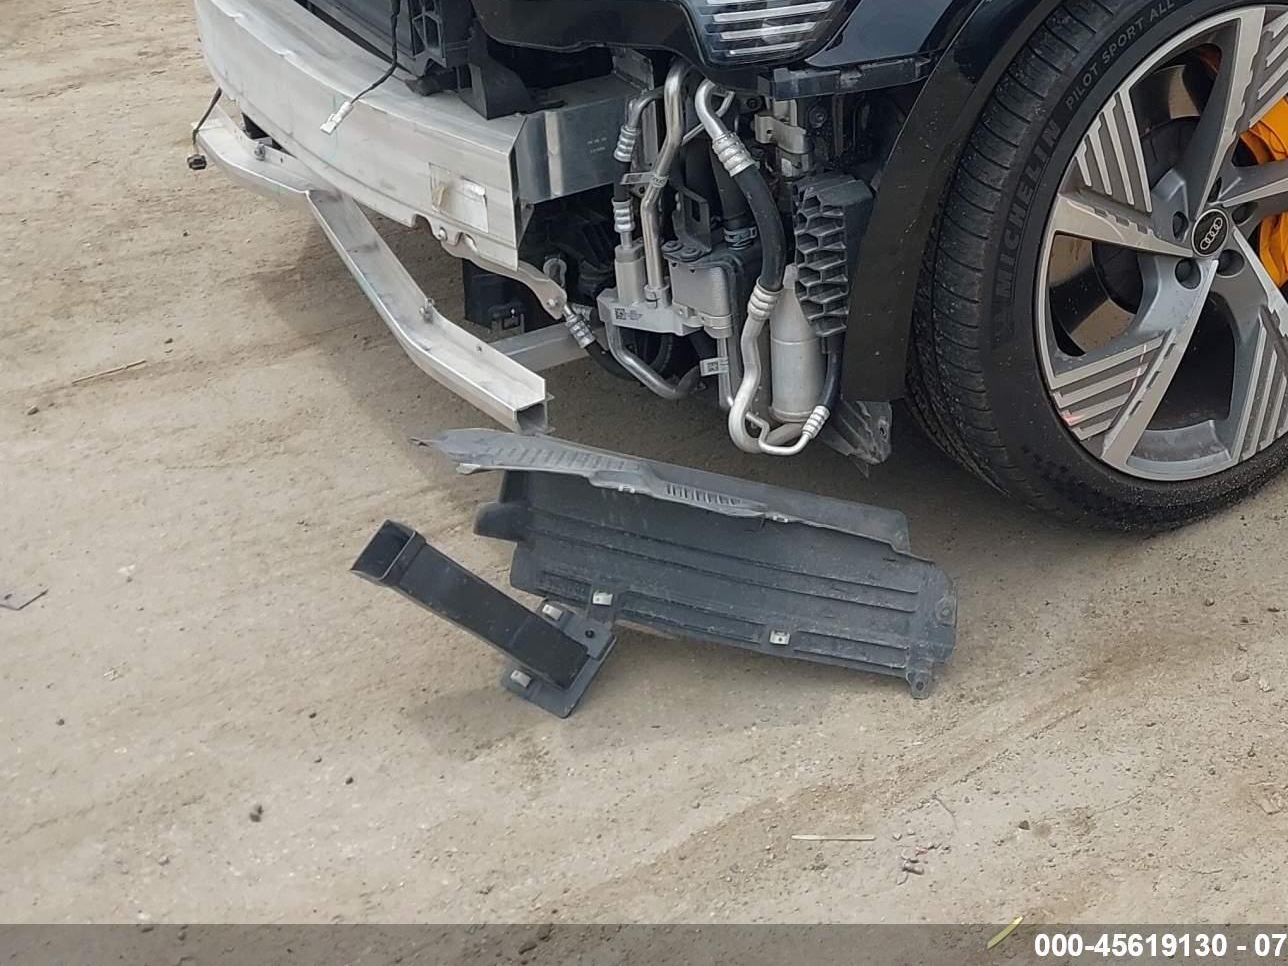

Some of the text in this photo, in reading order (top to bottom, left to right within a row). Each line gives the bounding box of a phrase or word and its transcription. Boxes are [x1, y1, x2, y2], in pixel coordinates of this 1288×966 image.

[1065, 65, 1099, 110] PILOT
[1102, 17, 1145, 64] SPORT
[995, 120, 1062, 299] MICHELIN
